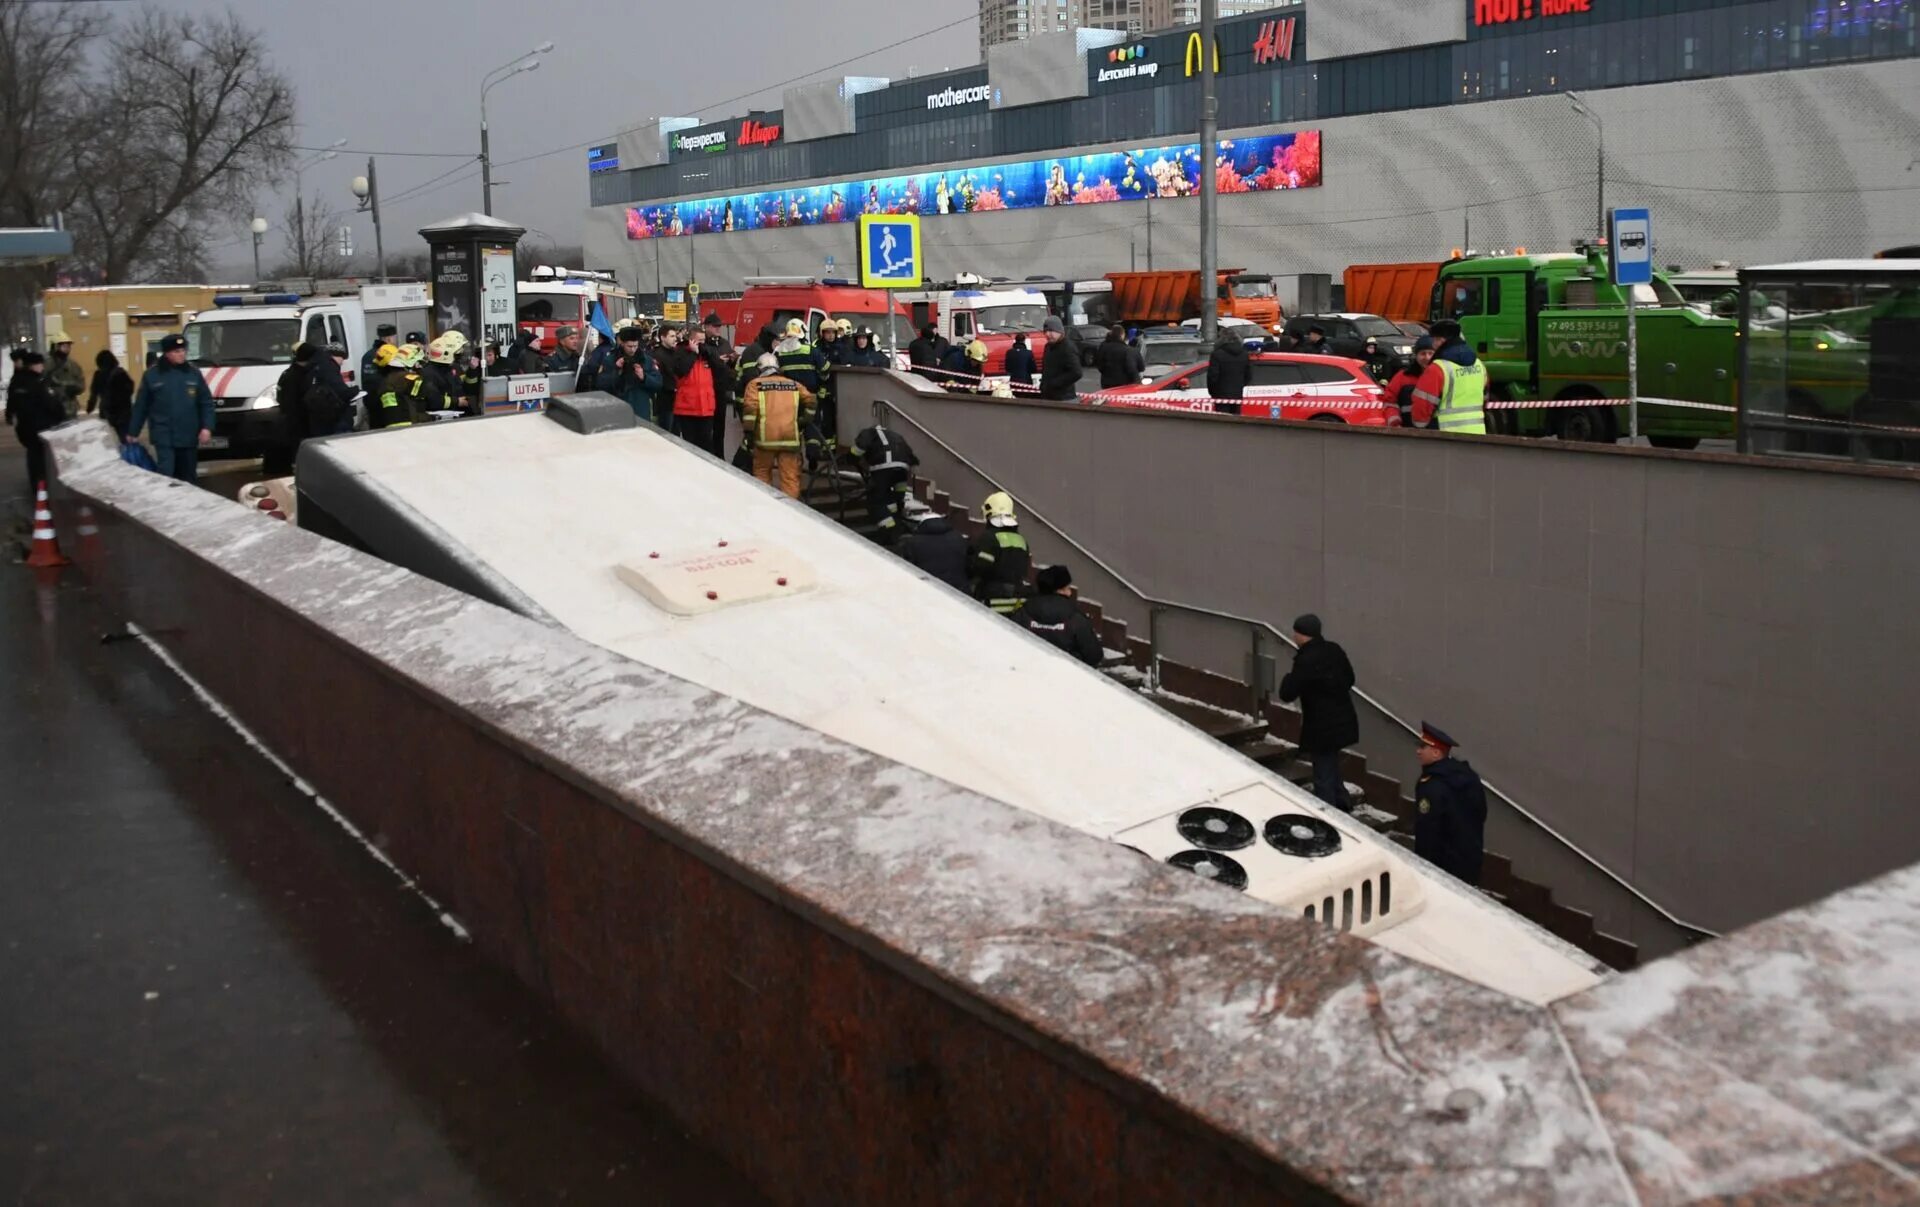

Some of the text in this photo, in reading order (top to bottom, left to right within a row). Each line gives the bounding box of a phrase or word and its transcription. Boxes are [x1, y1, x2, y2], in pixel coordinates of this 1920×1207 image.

[1253, 17, 1296, 65] H&M
[1098, 62, 1158, 82] Детский мир
[927, 85, 990, 110] mothercare
[515, 383, 545, 395] ШТАБ
